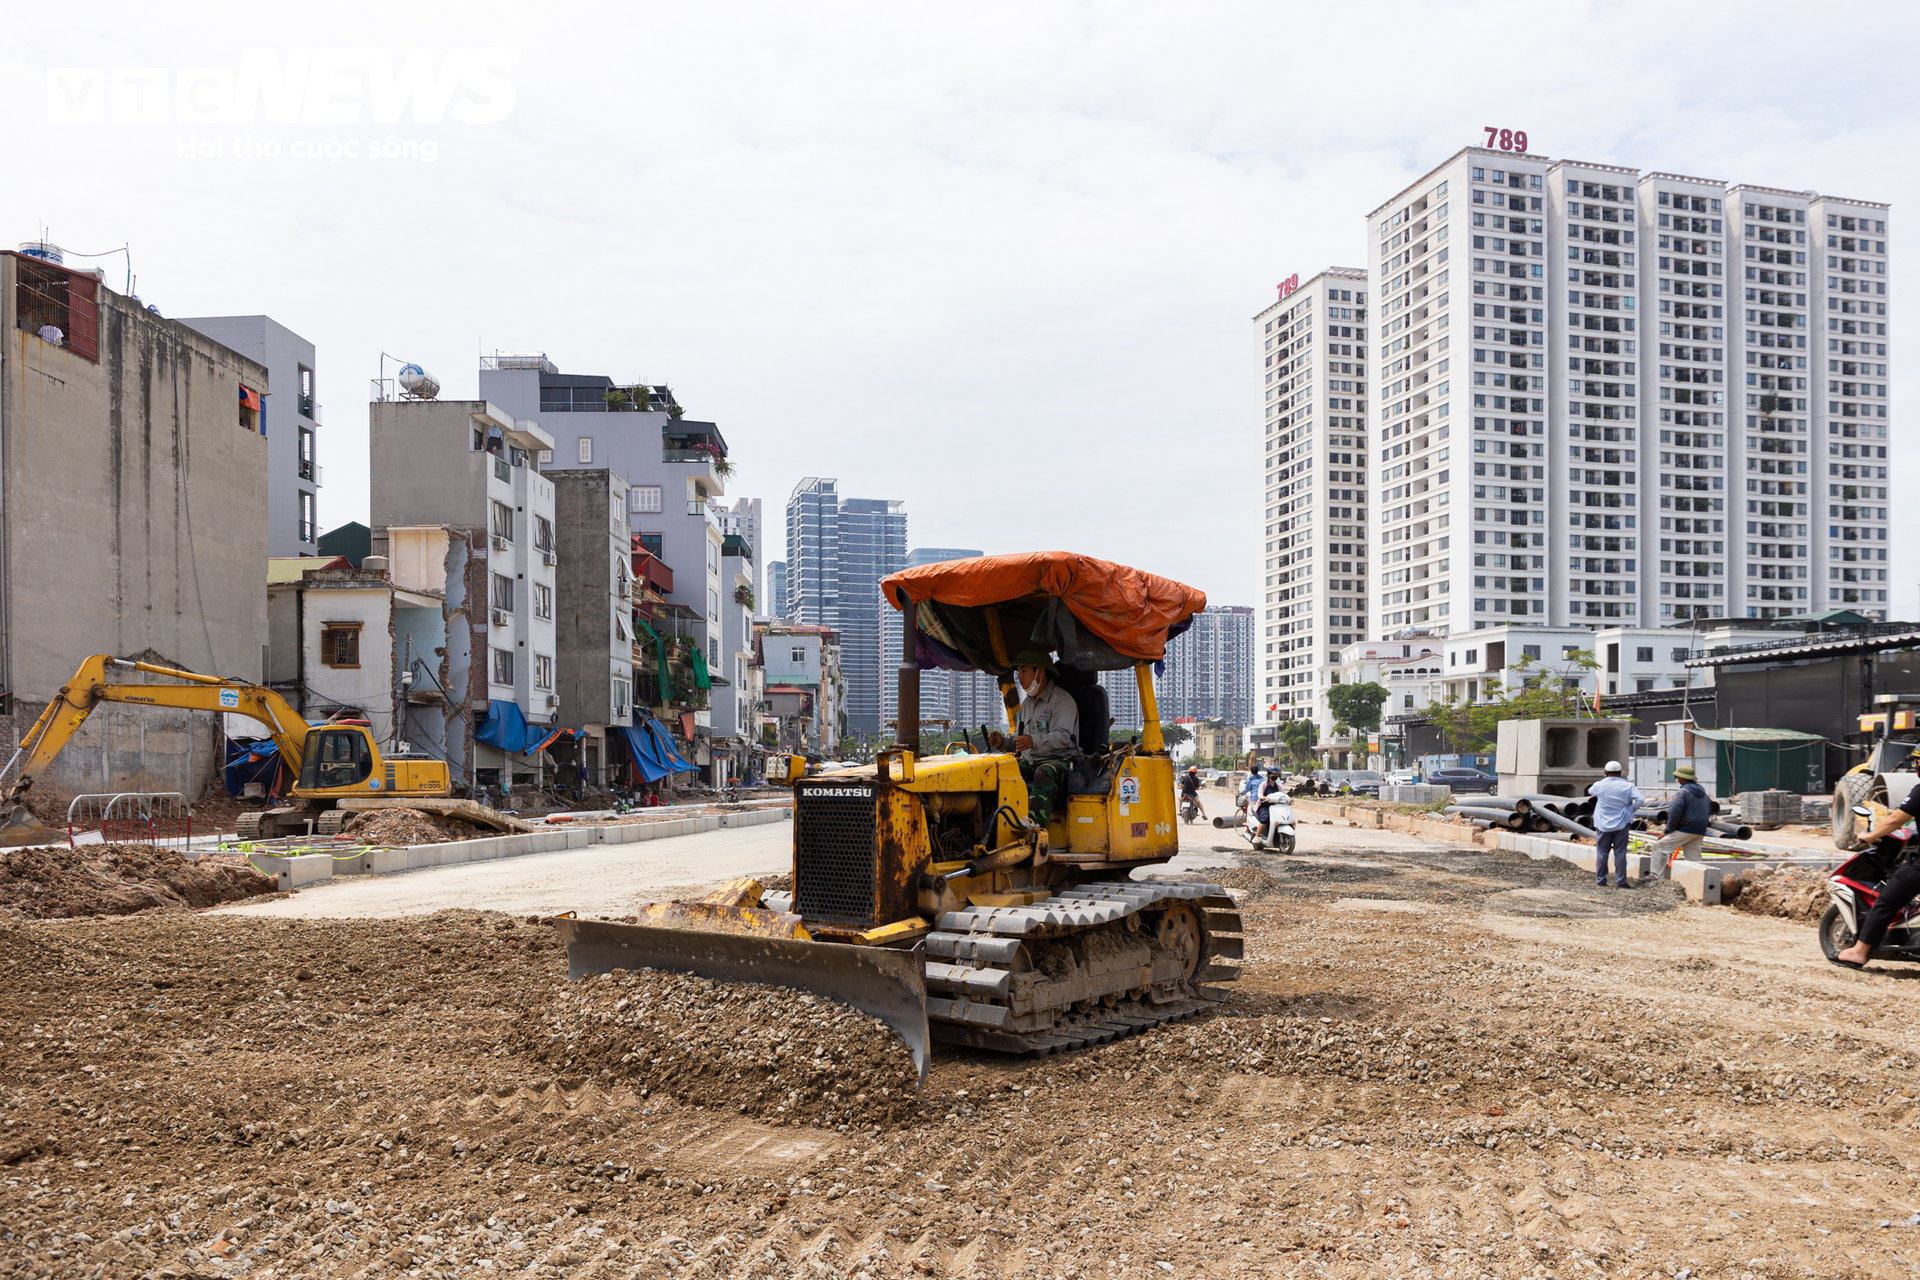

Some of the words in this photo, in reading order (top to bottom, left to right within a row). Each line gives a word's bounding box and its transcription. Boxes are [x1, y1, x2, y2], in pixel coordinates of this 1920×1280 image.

[1484, 126, 1528, 153] 789
[1276, 273, 1298, 300] 789
[802, 788, 872, 797] KOMATSU
